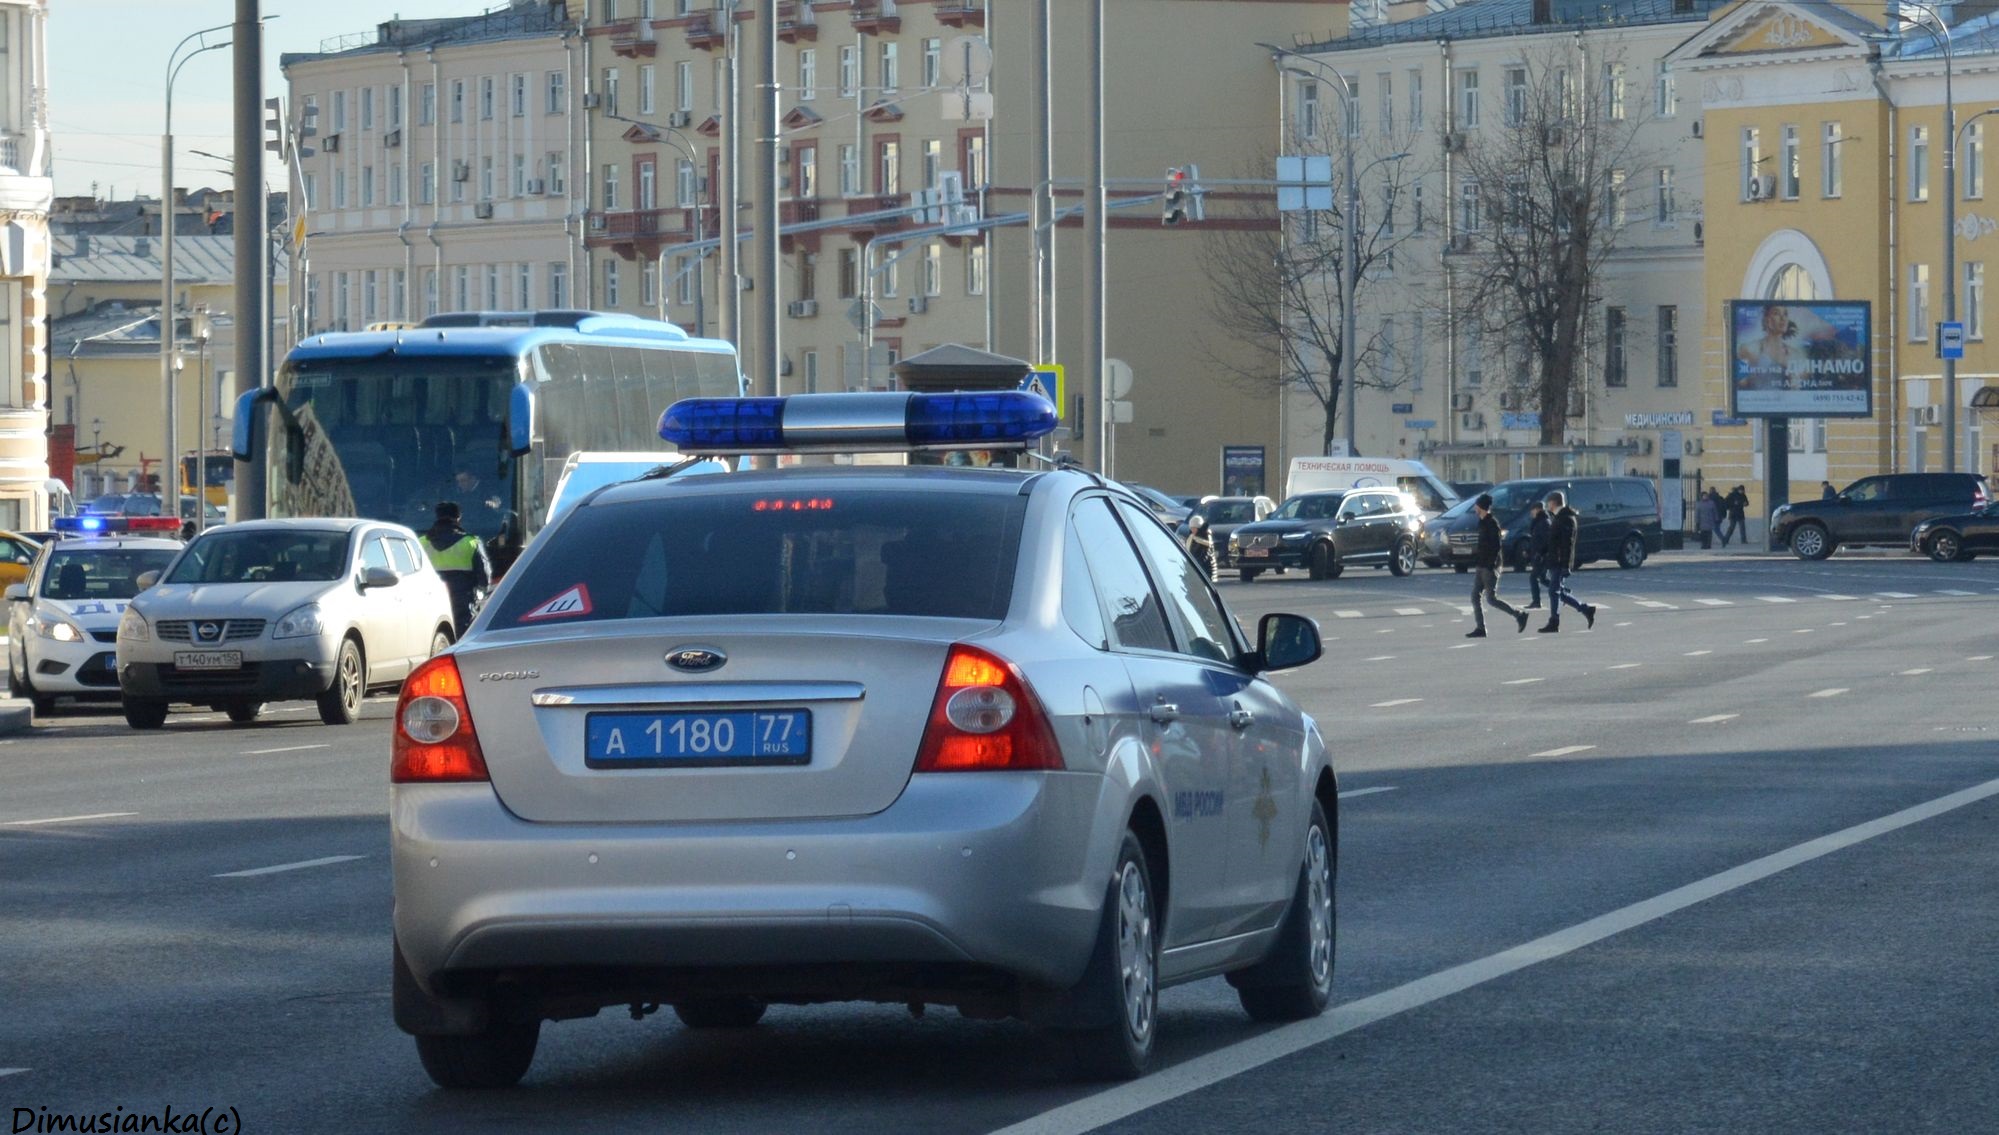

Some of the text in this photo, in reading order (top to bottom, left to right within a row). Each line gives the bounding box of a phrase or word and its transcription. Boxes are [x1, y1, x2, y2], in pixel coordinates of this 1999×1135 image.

[1785, 359, 1864, 376] ДИНАМО
[1625, 411, 1693, 426] МЕДИЦИНСКИЙ
[1298, 461, 1390, 473] ТЕХНИЧЕСКАЯ ПОМОЩЬ
[546, 598, 577, 612] Ш
[678, 651, 711, 666] Ford
[479, 670, 540, 682] FOCUS
[606, 714, 794, 754] А 1180 77
[763, 743, 790, 754] RUS
